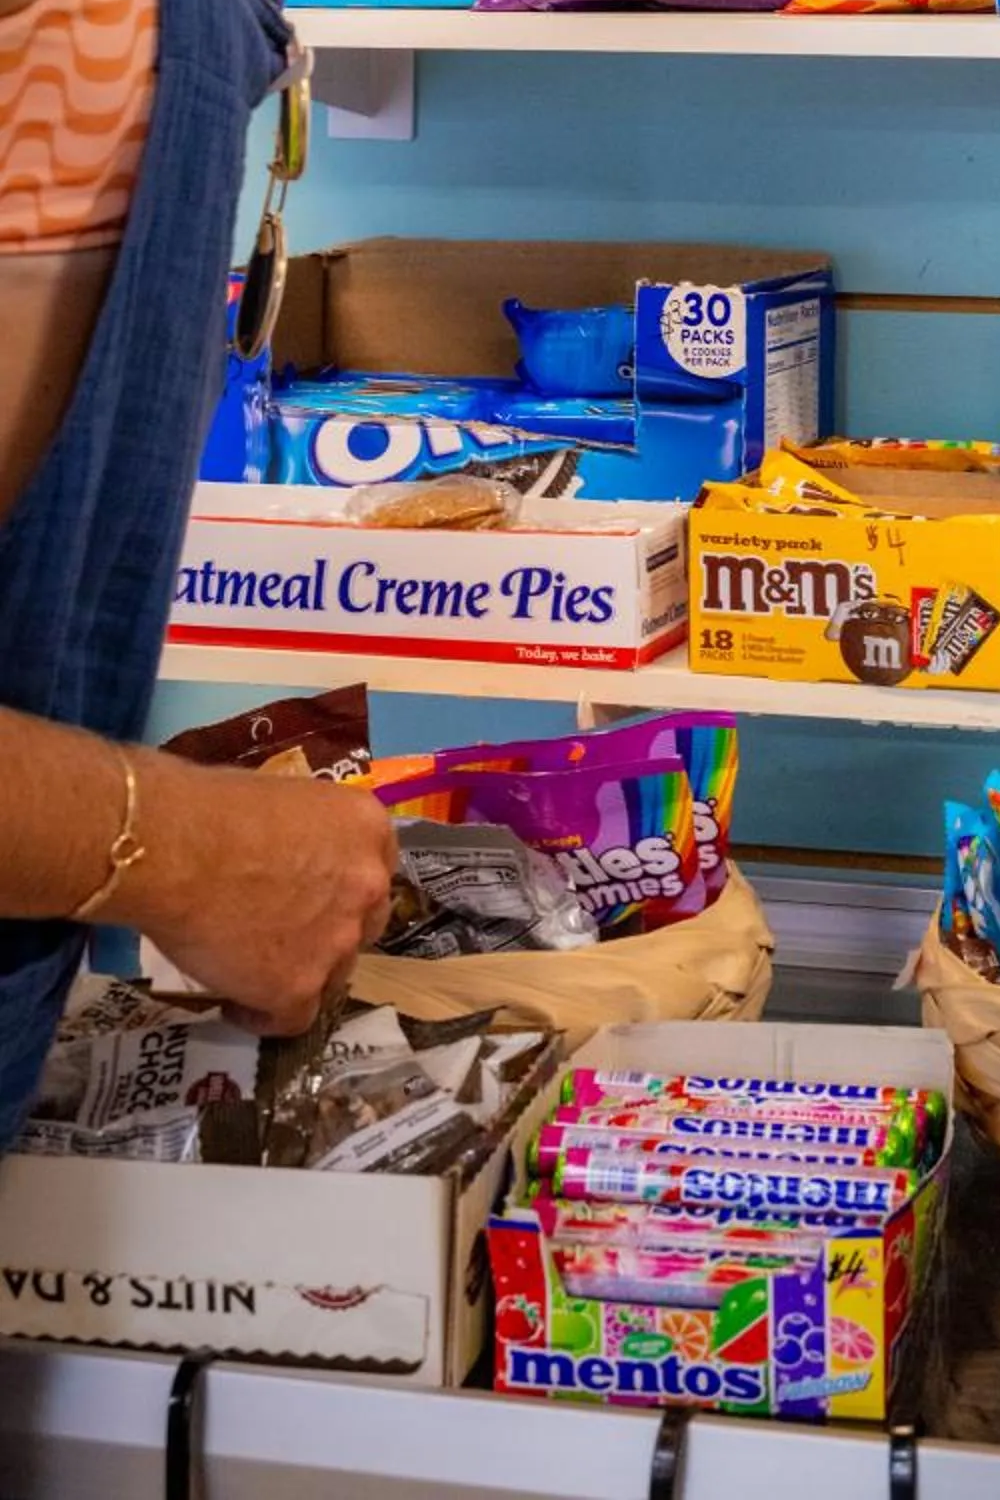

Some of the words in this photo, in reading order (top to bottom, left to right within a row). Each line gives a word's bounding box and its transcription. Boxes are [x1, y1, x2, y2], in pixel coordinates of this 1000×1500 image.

[683, 291, 731, 327] 30
[680, 329, 735, 346] PACKS
[699, 531, 772, 551] variety
[775, 536, 823, 552] pack
[176, 558, 325, 611] atmeal
[339, 561, 490, 618] Creme
[501, 567, 615, 624] Pies
[699, 649, 734, 662] PACKS
[700, 628, 734, 651] 18
[161, 1023, 190, 1086] NUTS
[681, 1168, 893, 1213] mentos
[509, 1348, 763, 1400] mentos
